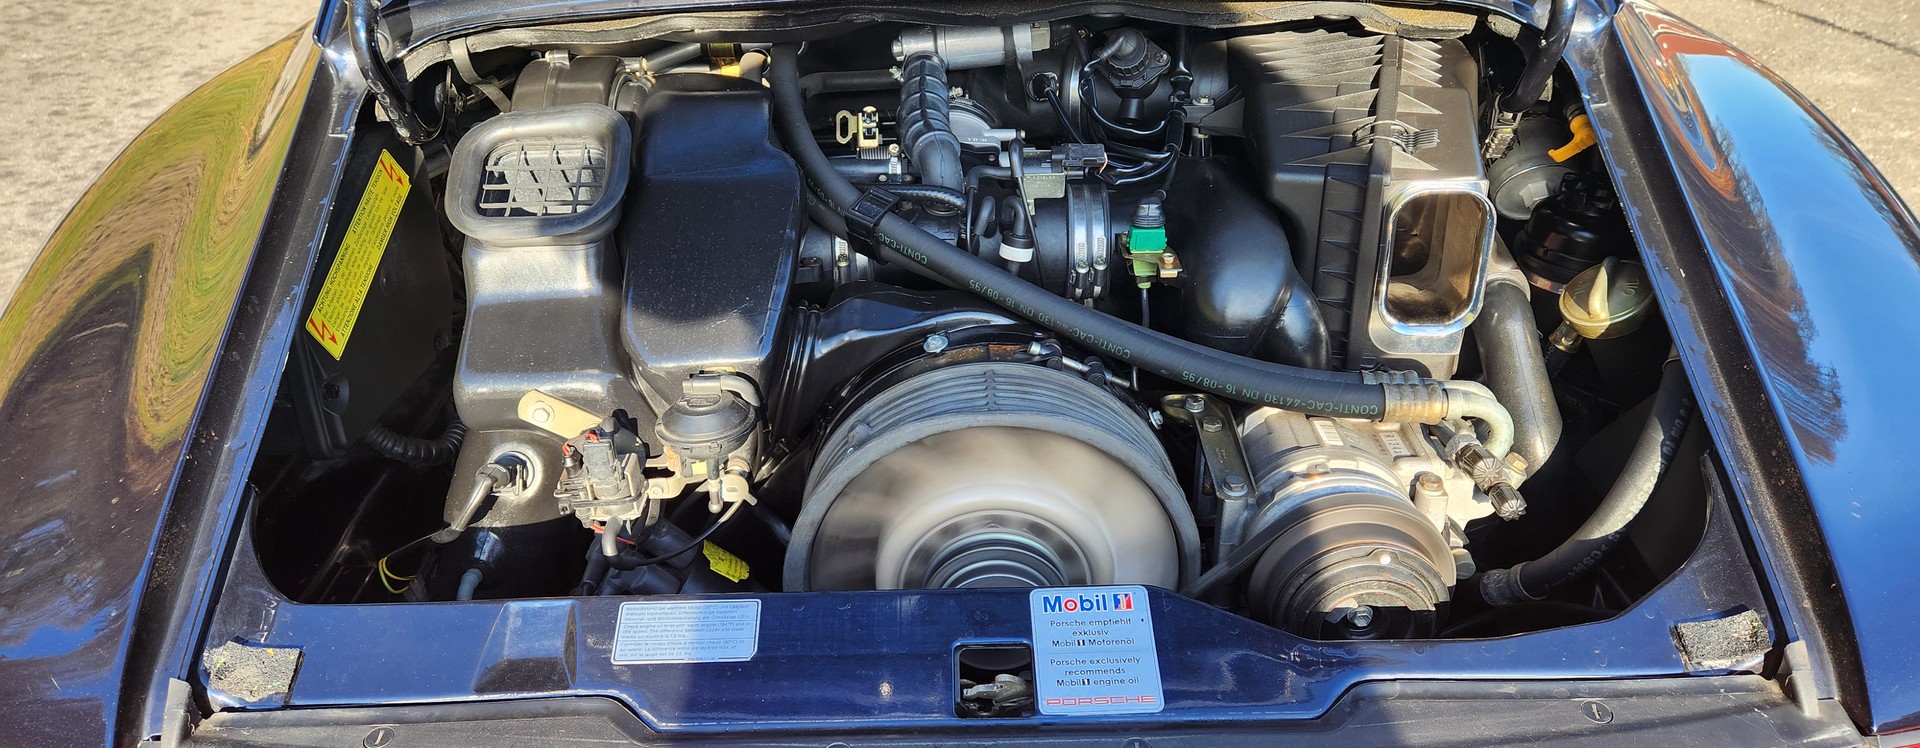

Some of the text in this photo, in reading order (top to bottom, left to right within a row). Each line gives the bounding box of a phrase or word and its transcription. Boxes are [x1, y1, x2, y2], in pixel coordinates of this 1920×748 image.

[352, 168, 382, 234] ATTENTION HAUTE TENSION
[376, 227, 387, 251] DANGER
[390, 192, 402, 217] VOLTAGE
[317, 241, 350, 314] ACHTUNG HOCHSPANNUNG
[340, 262, 373, 338] ATTENZIONE ALTA TENSIONE
[1019, 305, 1034, 317] DN
[1242, 389, 1259, 400] DN
[1264, 394, 1379, 416] CONTI-CAC-44130
[1043, 594, 1107, 613] Mobil
[1089, 618, 1132, 629] empfiehlt
[1072, 629, 1109, 637] exklusiv
[1089, 637, 1135, 646] Motorenöl
[1089, 657, 1141, 666] exclusively
[1065, 667, 1126, 675] recommends
[1093, 678, 1125, 687] engine
[1128, 677, 1139, 685] oil
[1046, 695, 1155, 706] PORSCHE
